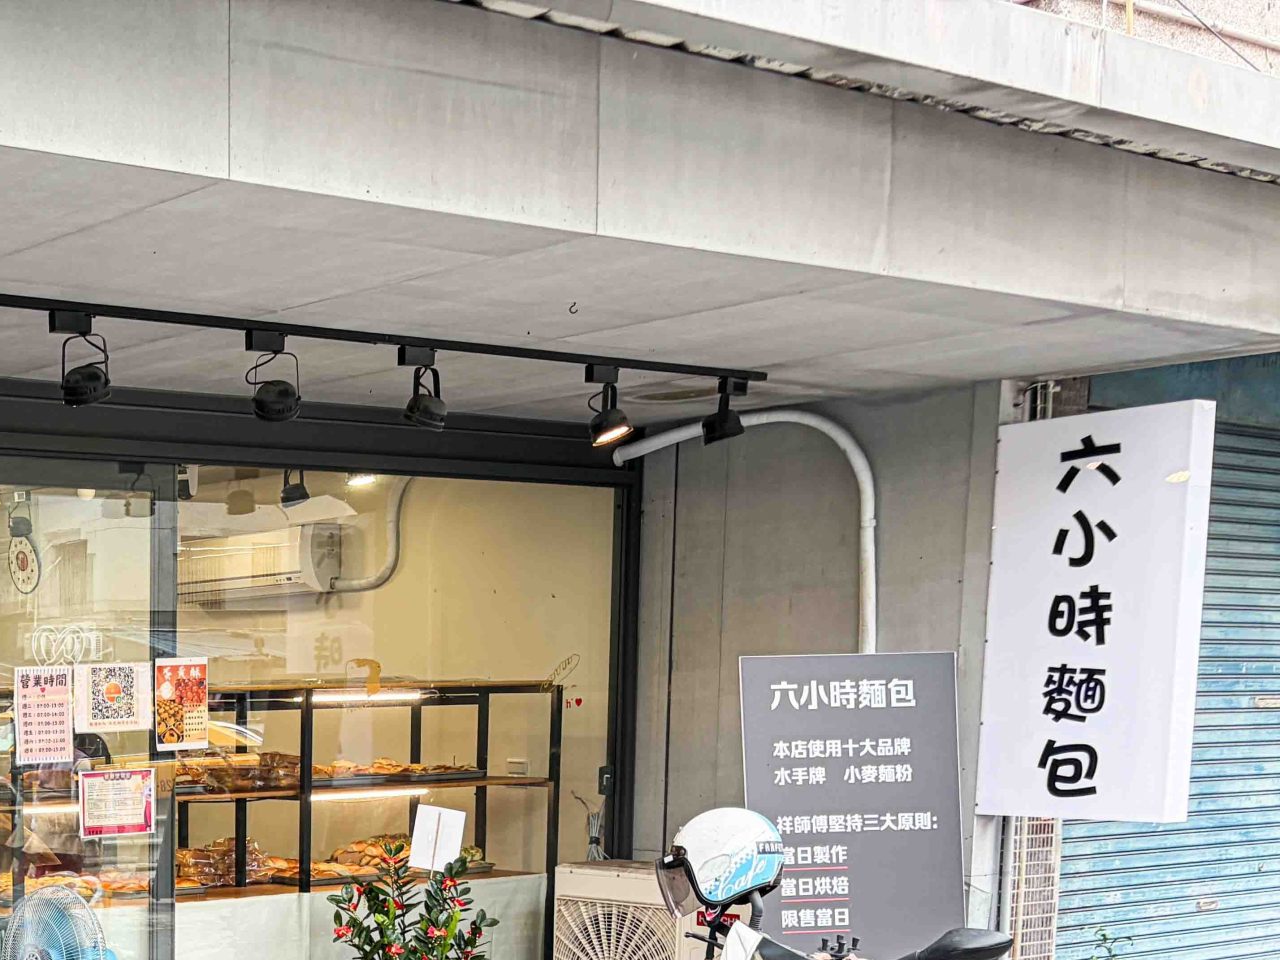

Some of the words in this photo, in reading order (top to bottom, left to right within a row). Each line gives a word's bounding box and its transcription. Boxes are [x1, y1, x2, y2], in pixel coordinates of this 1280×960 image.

[1037, 433, 1122, 799] 六小時麵包
[20, 673, 67, 689] 營業時間
[770, 678, 917, 711] 六小時麵包
[773, 737, 912, 759] 本店使用十大品牌
[774, 766, 827, 786] 水手牌
[843, 764, 913, 784] 小麥麵粉
[782, 845, 848, 865] 當日製作
[781, 876, 850, 897] 當日烘焙
[781, 908, 851, 929] 限售當日
